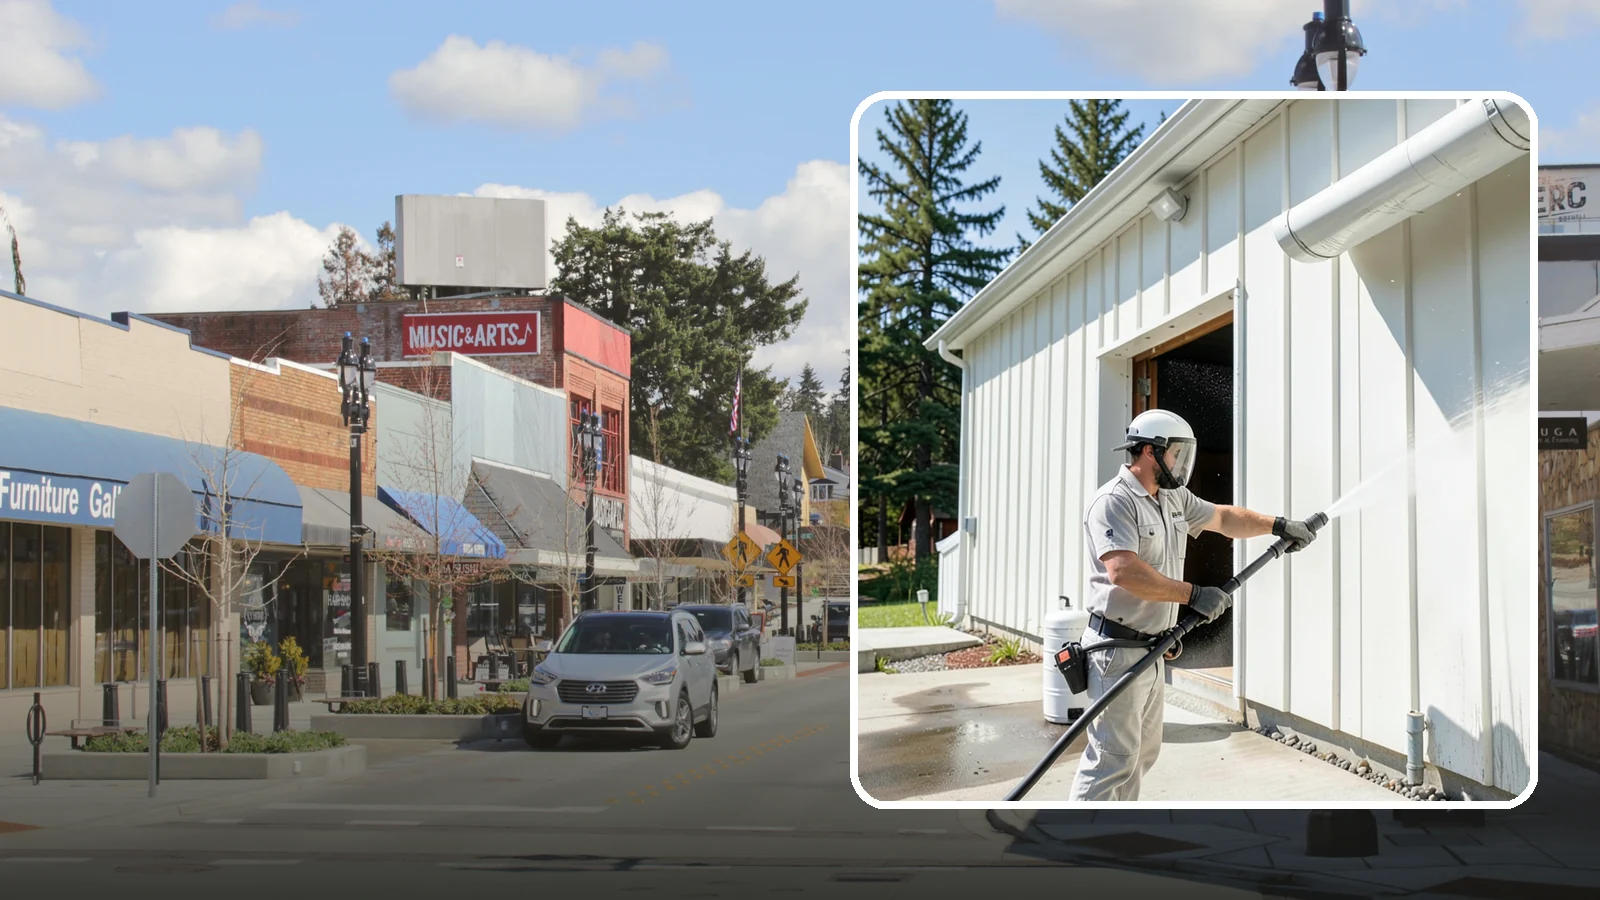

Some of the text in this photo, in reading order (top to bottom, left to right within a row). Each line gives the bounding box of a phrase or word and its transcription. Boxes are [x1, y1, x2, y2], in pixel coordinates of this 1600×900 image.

[1540, 427, 1577, 436] UGA
[0, 471, 122, 519] Furniture Gal
[453, 563, 479, 574] SUSHI
